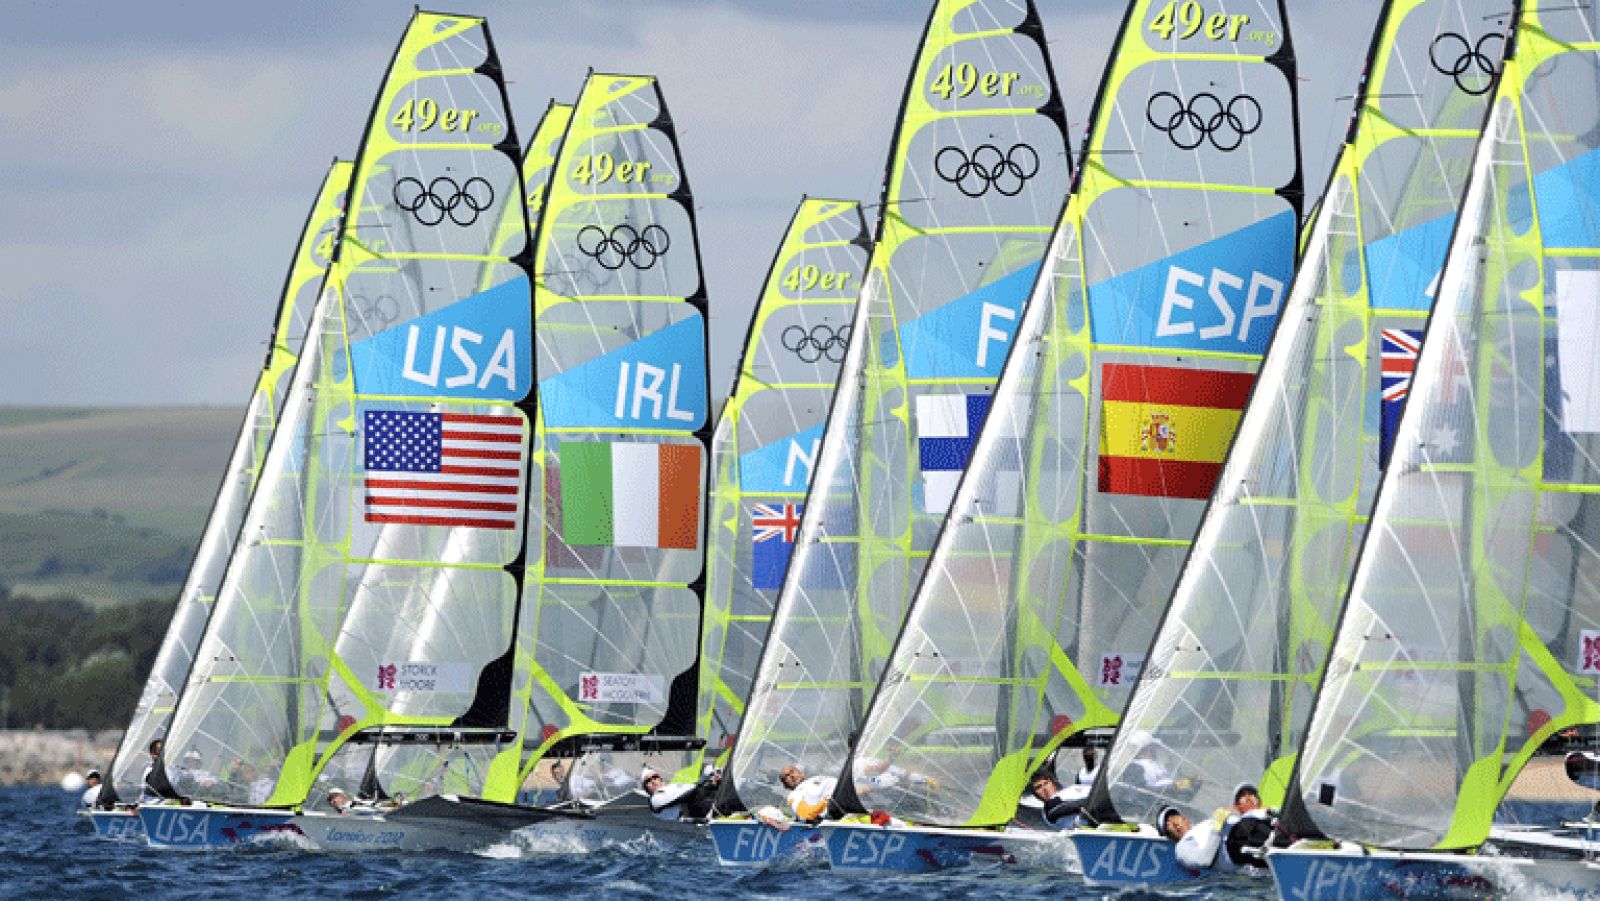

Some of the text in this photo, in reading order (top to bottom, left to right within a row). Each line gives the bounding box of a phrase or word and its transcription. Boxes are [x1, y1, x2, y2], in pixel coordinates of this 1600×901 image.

[1148, 0, 1250, 41] 49er
[929, 62, 1020, 100] 49er
[392, 98, 479, 133] 49er
[571, 154, 652, 186] 49er
[783, 265, 851, 292] 49er
[1156, 264, 1284, 343] ESP
[976, 302, 1027, 367] F
[402, 324, 516, 393] USA
[614, 361, 696, 421] IRL
[107, 818, 139, 841] FR
[156, 811, 210, 843] USA
[733, 828, 781, 858] FIN
[842, 832, 906, 865] ESP
[1091, 839, 1168, 878] AUS
